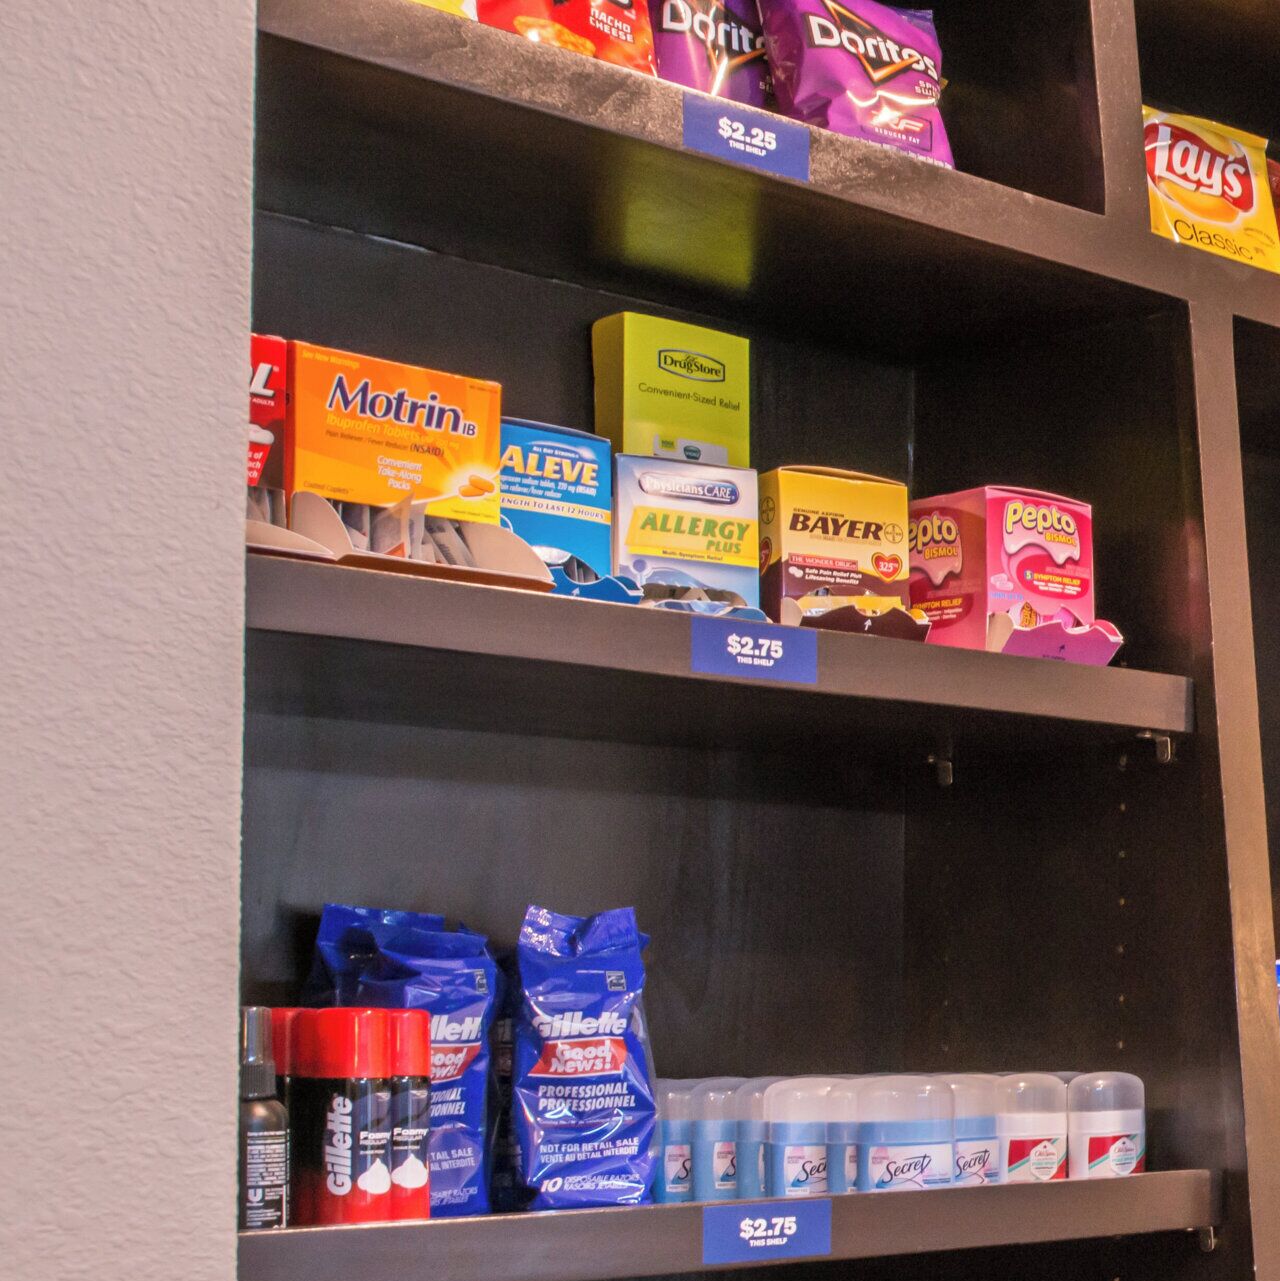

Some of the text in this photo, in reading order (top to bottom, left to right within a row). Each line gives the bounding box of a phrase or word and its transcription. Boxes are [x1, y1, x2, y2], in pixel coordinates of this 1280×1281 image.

[590, 16, 633, 43] CHEESE
[591, 8, 631, 34] NACHO
[809, 15, 938, 80] Doritos
[718, 115, 777, 151] $2.25
[728, 139, 767, 157] THIS SHELF
[1154, 124, 1247, 199] Lay's
[1174, 219, 1253, 262] Classic
[327, 375, 476, 436] Motrin IB
[639, 383, 716, 406] Convenient-Sized
[327, 413, 381, 434] Ibuprofen
[383, 421, 420, 442] Tablets
[410, 443, 445, 458] (NSAID)
[501, 445, 599, 487] ALEVE
[640, 512, 750, 540] ALLERGY
[789, 513, 884, 542] BAYER
[1006, 499, 1076, 533] Pepto
[705, 539, 742, 554] PLUS
[1045, 532, 1077, 546] BISMOL
[924, 546, 958, 559] BISMOL
[727, 634, 784, 659] $2.75
[737, 656, 775, 667] THIS SHELF
[532, 1011, 627, 1037] Gillette
[556, 1039, 611, 1061] Good
[549, 1057, 611, 1072] News!
[538, 1082, 628, 1097] PROFESSIONAL
[539, 1095, 636, 1111] PROFESSIONNEL
[327, 1095, 352, 1196] Gillette
[540, 1137, 639, 1153] NOT FOR RETAIL SALE
[882, 1154, 931, 1183] Secret
[956, 1149, 990, 1178] Secret
[541, 1178, 563, 1192] 10
[740, 1216, 797, 1239] $2.75
[750, 1237, 787, 1247] THIS SHELF
